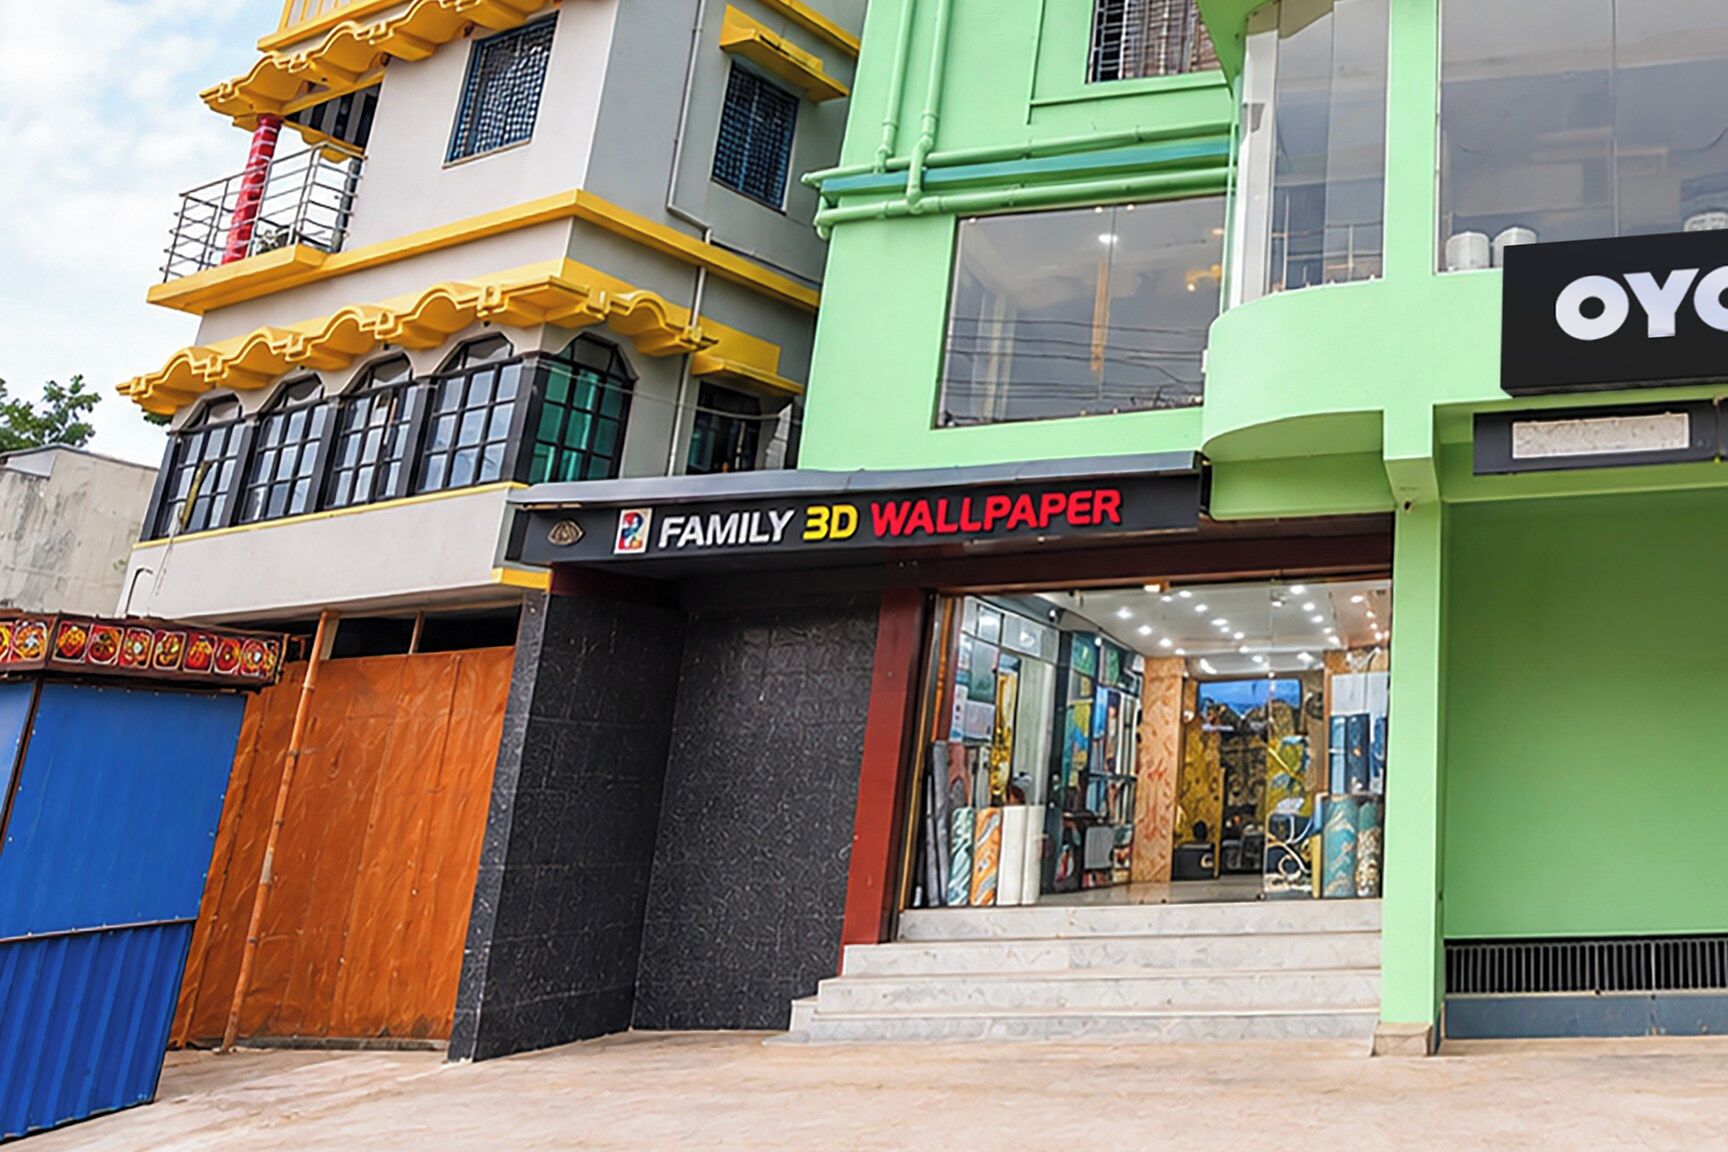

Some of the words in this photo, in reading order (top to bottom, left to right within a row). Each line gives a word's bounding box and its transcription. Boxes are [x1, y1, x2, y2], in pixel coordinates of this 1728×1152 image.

[658, 507, 796, 549] FAMILY
[802, 504, 859, 541] 3D
[871, 489, 1123, 538] WALLPAPER
